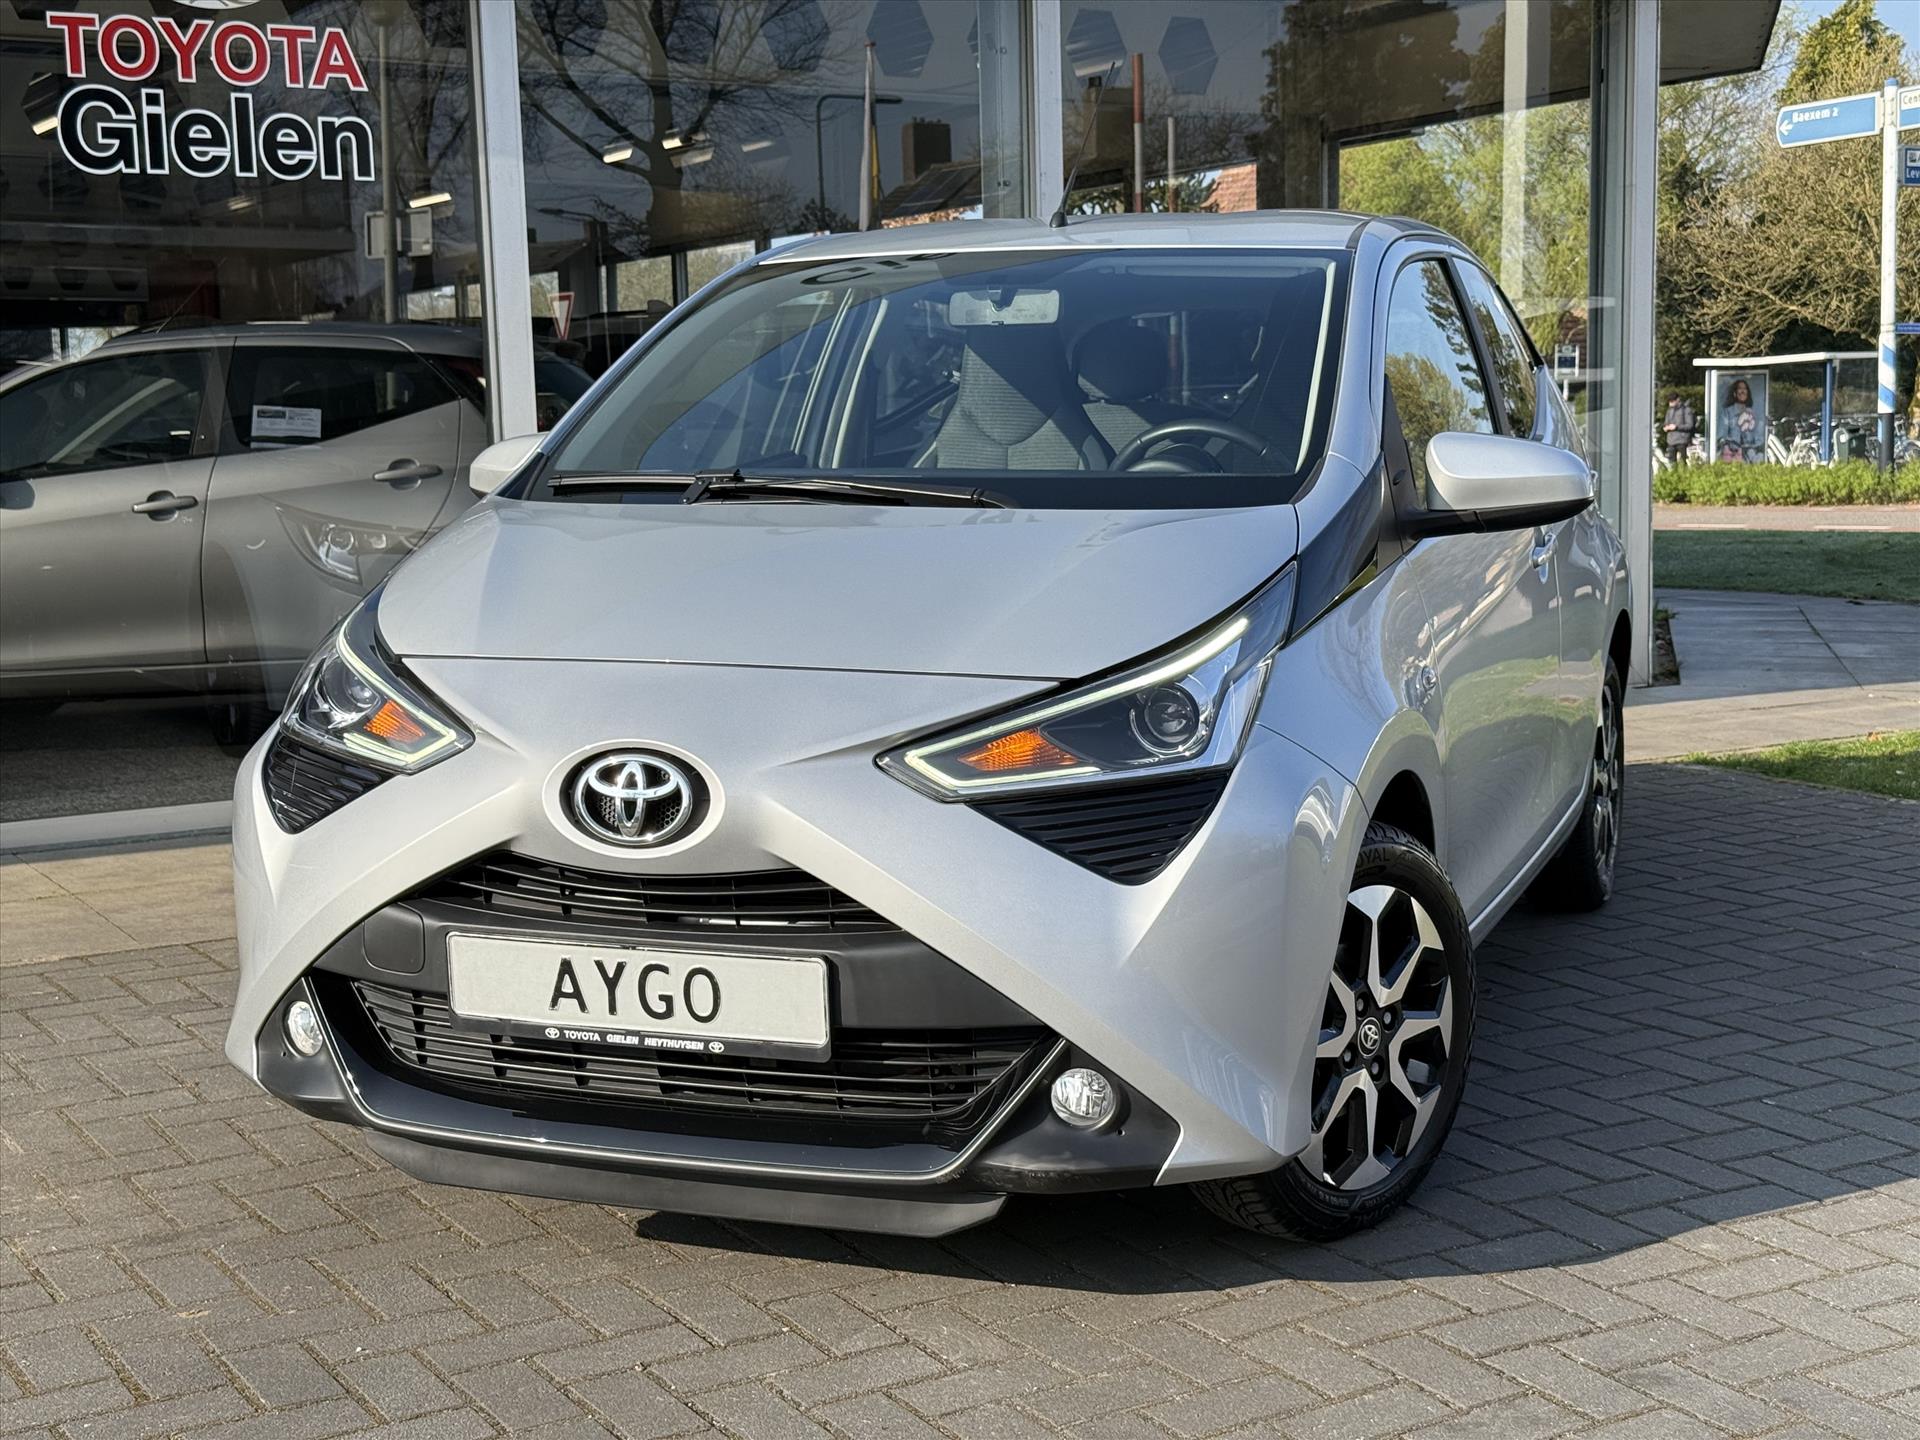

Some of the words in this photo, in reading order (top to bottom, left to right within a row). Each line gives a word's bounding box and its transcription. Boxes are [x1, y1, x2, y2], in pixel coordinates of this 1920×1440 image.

[46, 11, 369, 92] TOYOTA
[57, 84, 376, 182] Gielen
[1832, 106, 1839, 117] 2
[548, 955, 721, 1024] AYGO
[563, 1029, 600, 1041] TOYOTA
[606, 1033, 639, 1045] GIELEN
[644, 1037, 704, 1050] HEYTHUYSEN
